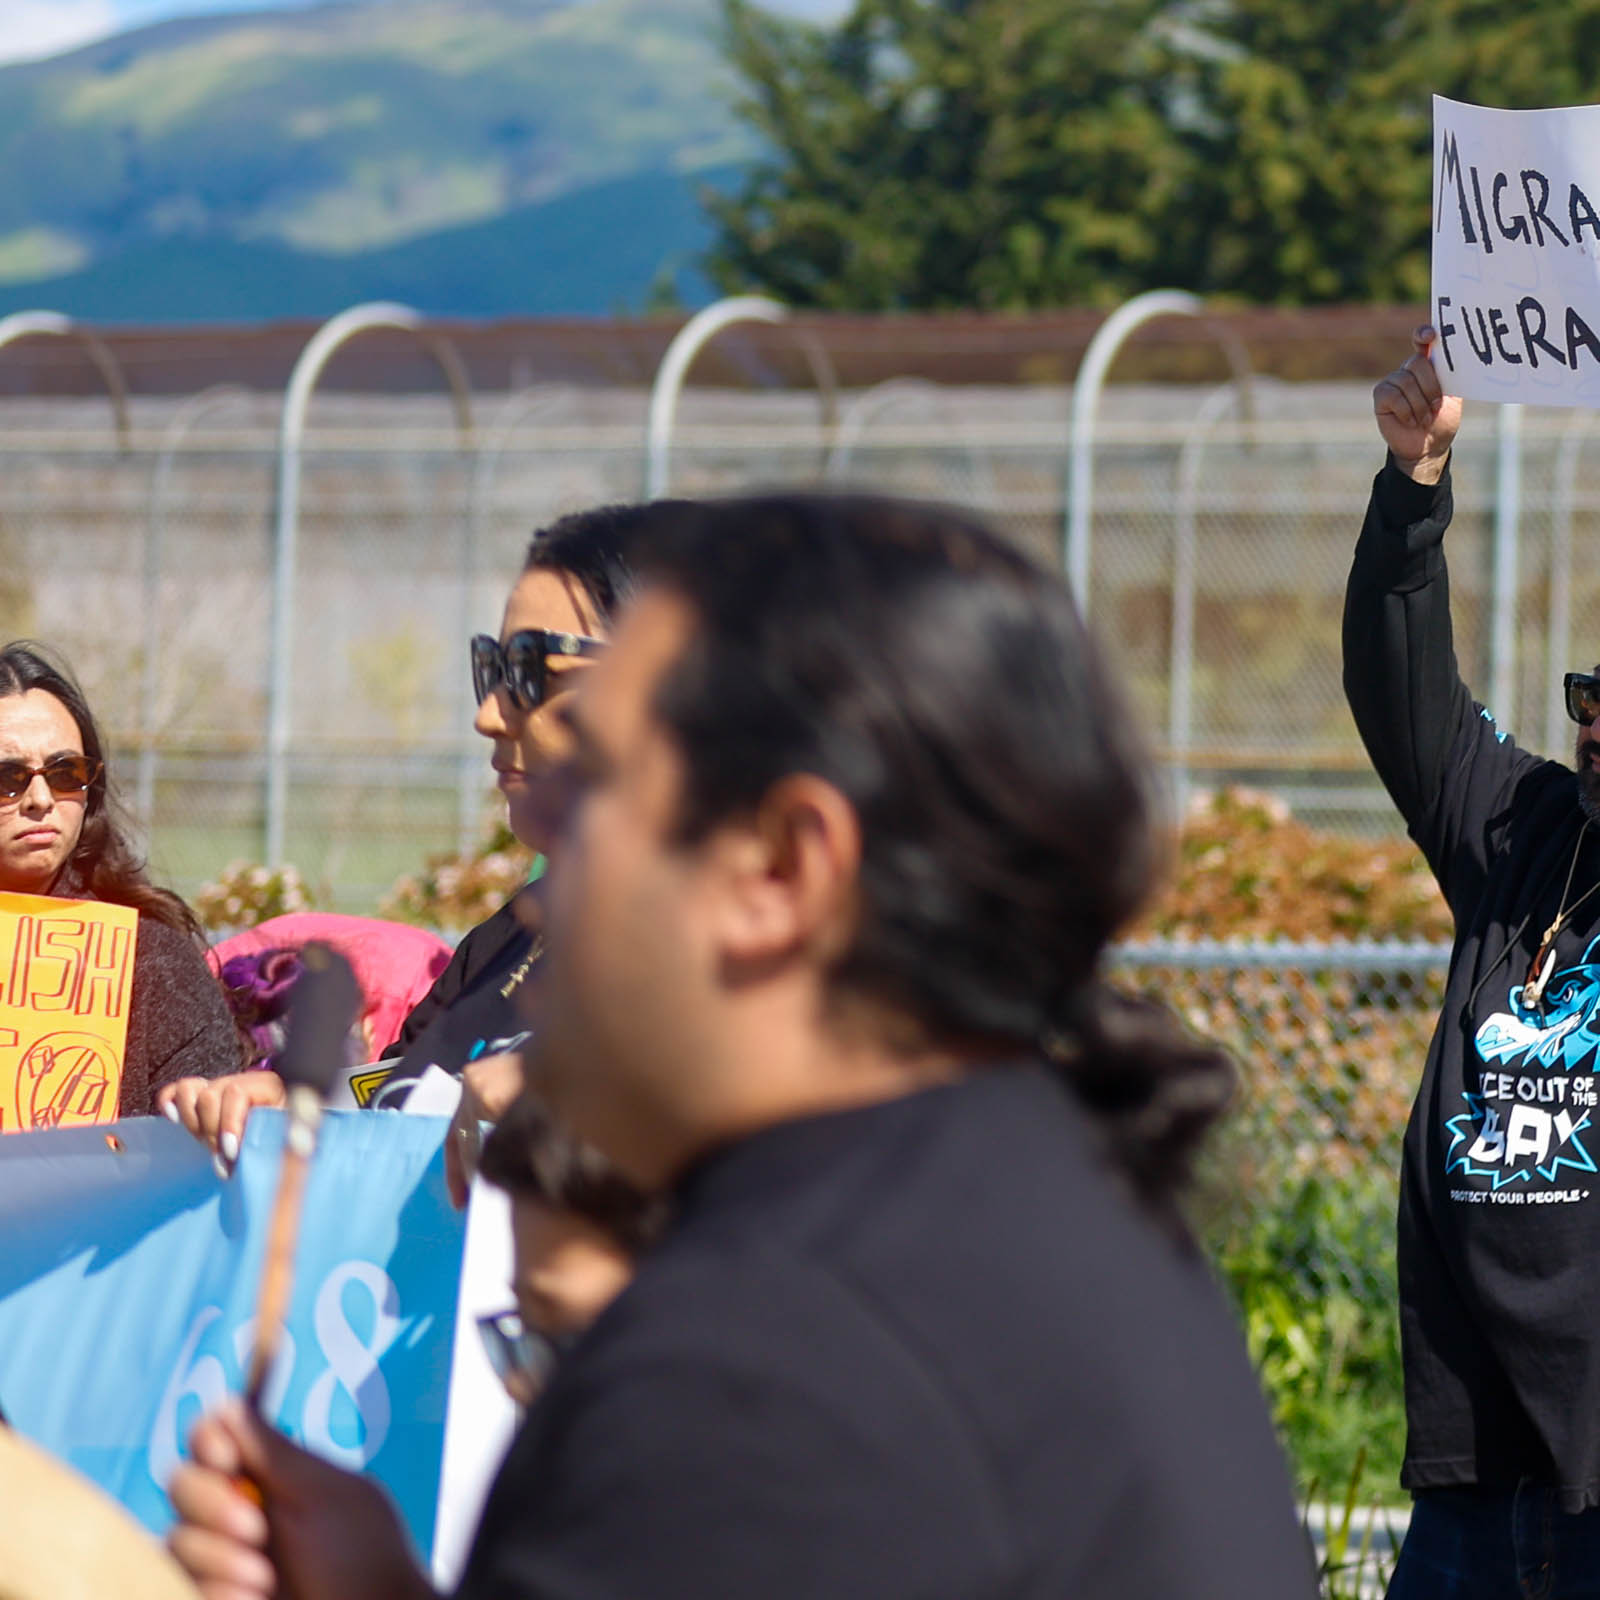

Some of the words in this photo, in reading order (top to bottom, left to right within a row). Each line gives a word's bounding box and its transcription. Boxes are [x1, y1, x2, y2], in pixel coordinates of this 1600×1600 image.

[0, 915, 132, 1018] ISH
[1517, 1076, 1569, 1103] OUT
[1573, 1076, 1595, 1092] OF
[1571, 1092, 1598, 1106] THE
[1467, 1103, 1591, 1167] BAY
[1490, 1191, 1525, 1204] YOUR
[1526, 1189, 1581, 1205] PEOPLE
